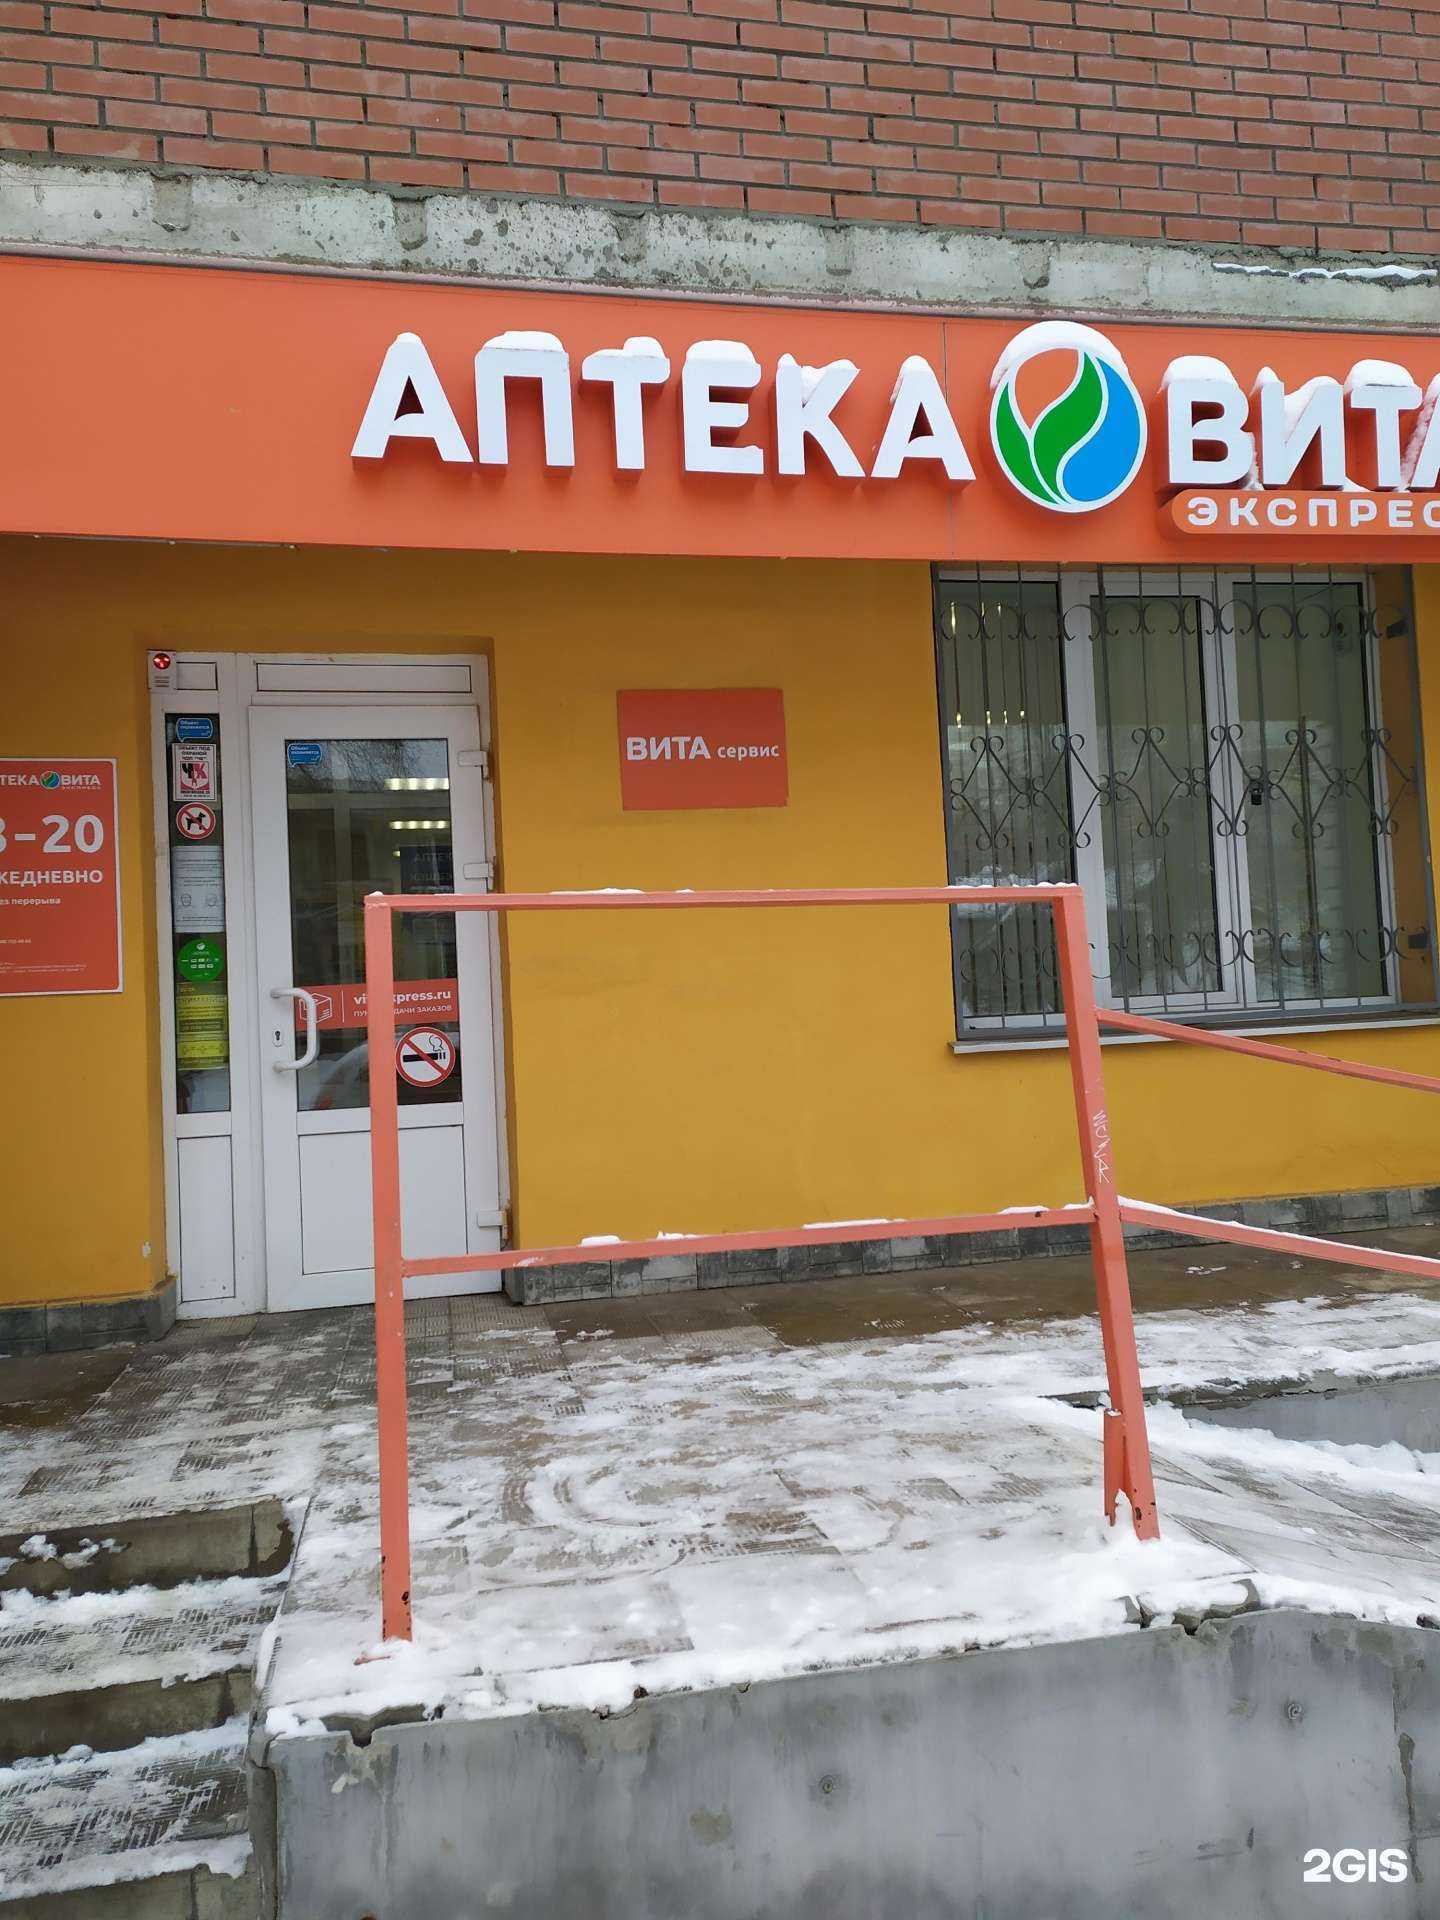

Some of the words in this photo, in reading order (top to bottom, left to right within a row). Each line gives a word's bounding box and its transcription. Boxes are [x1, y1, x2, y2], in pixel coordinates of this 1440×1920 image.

[351, 333, 976, 481] АПТЕКА
[1187, 497, 1440, 528] ЭКСПРЕС
[626, 736, 711, 761] ВИТА
[717, 745, 780, 761] сервис
[61, 774, 101, 786] ВИТА
[0, 814, 104, 853] -20
[12, 897, 61, 906] перерыва
[416, 1003, 452, 1014] ЗАКАЗОВ
